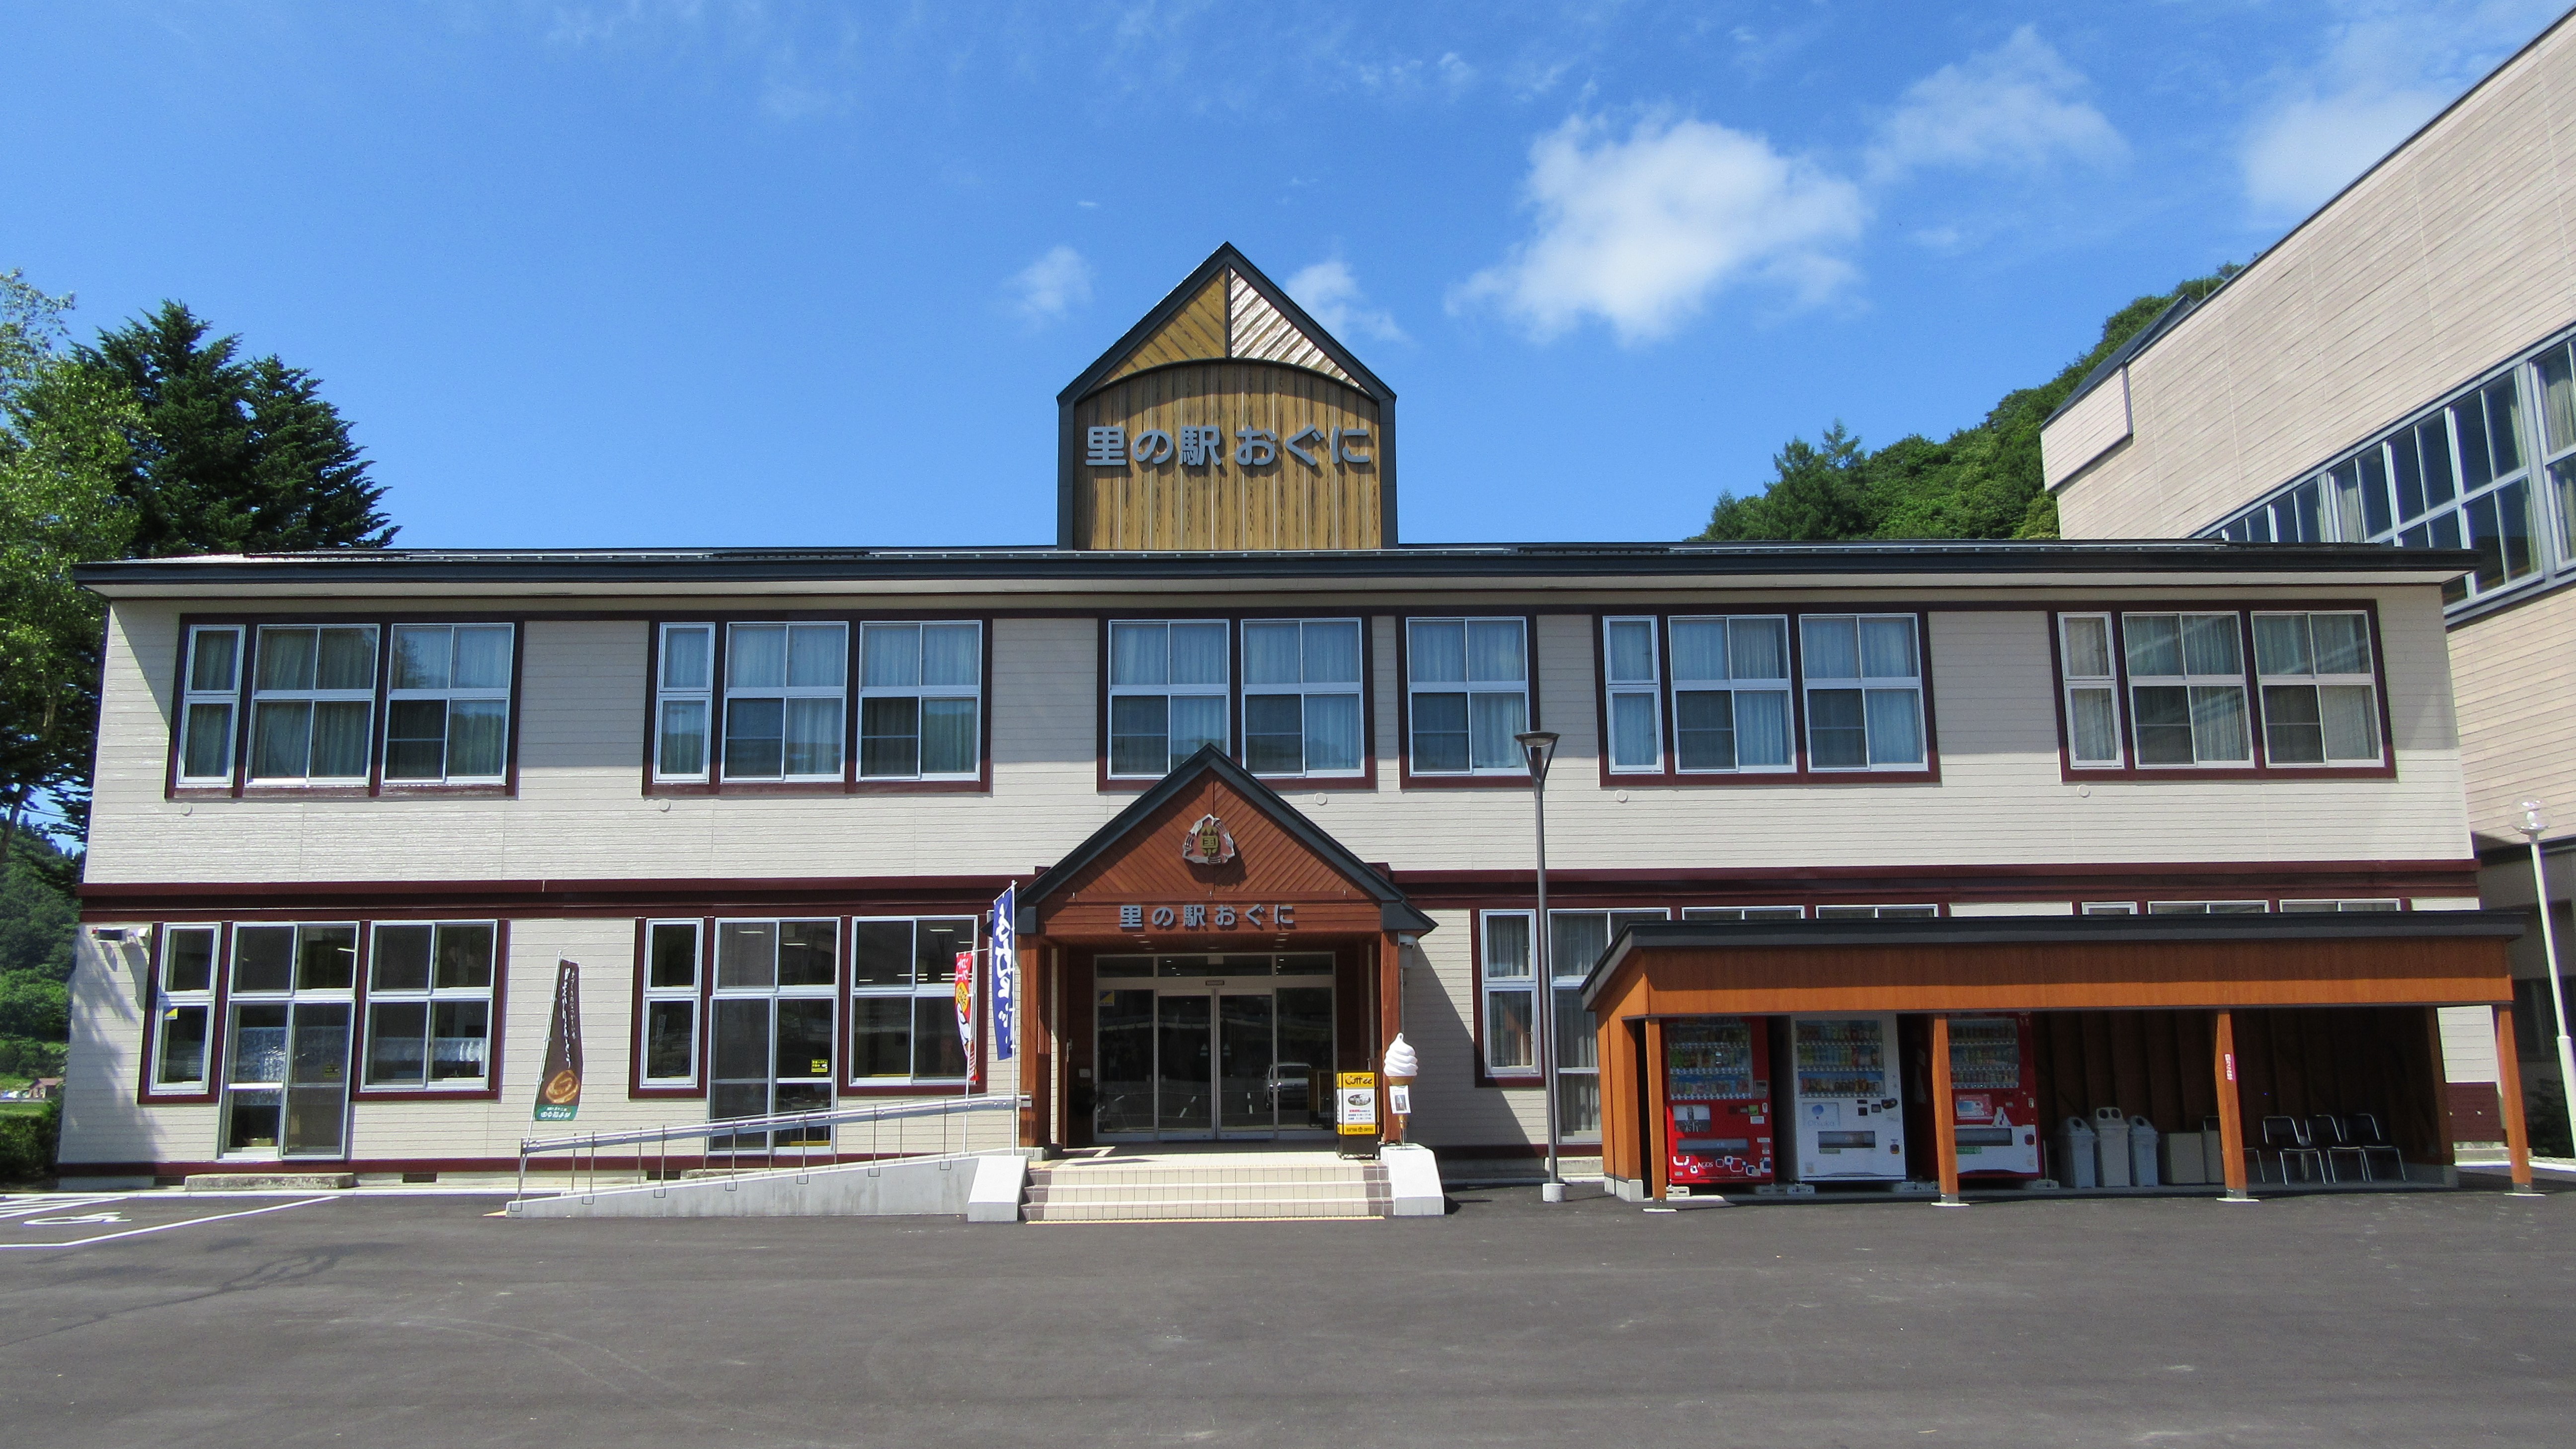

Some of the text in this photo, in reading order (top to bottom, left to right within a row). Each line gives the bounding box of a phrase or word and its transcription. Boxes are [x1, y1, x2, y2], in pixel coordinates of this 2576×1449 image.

[1085, 424, 1370, 467] 里の駅おぐに
[1119, 904, 1294, 928] 里の駅おぐに
[1345, 1075, 1372, 1085] Coffee
